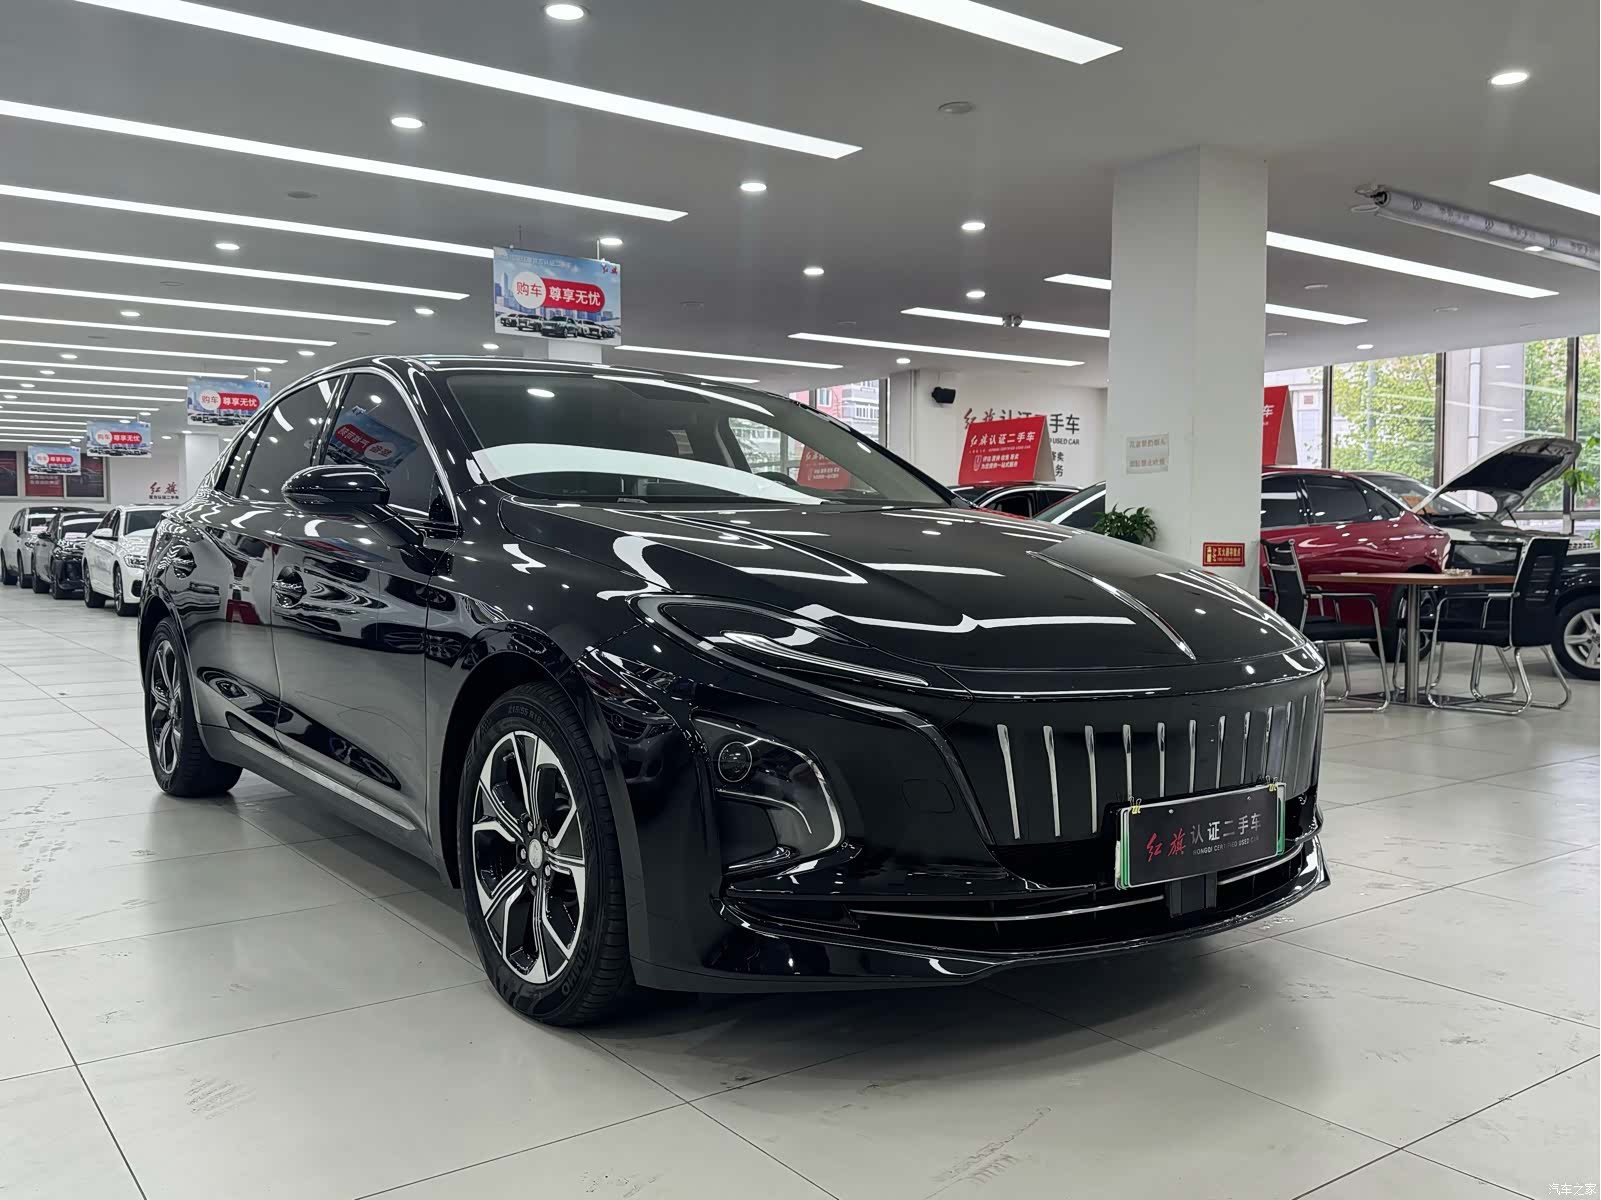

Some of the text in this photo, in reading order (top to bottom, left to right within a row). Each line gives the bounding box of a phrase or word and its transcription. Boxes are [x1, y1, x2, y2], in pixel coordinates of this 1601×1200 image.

[516, 281, 543, 298] 购车
[548, 286, 601, 306] 尊享无忧
[201, 394, 220, 405] 购车
[222, 396, 258, 408] 尊享无忧
[963, 407, 1080, 435] 红旗手车
[113, 435, 141, 443] 尊享无忧
[970, 431, 1036, 448] 红旗认证二手车
[1068, 438, 1080, 446] CAR
[149, 481, 178, 495] 红旗
[1146, 812, 1262, 862] 红旗认证二手车
